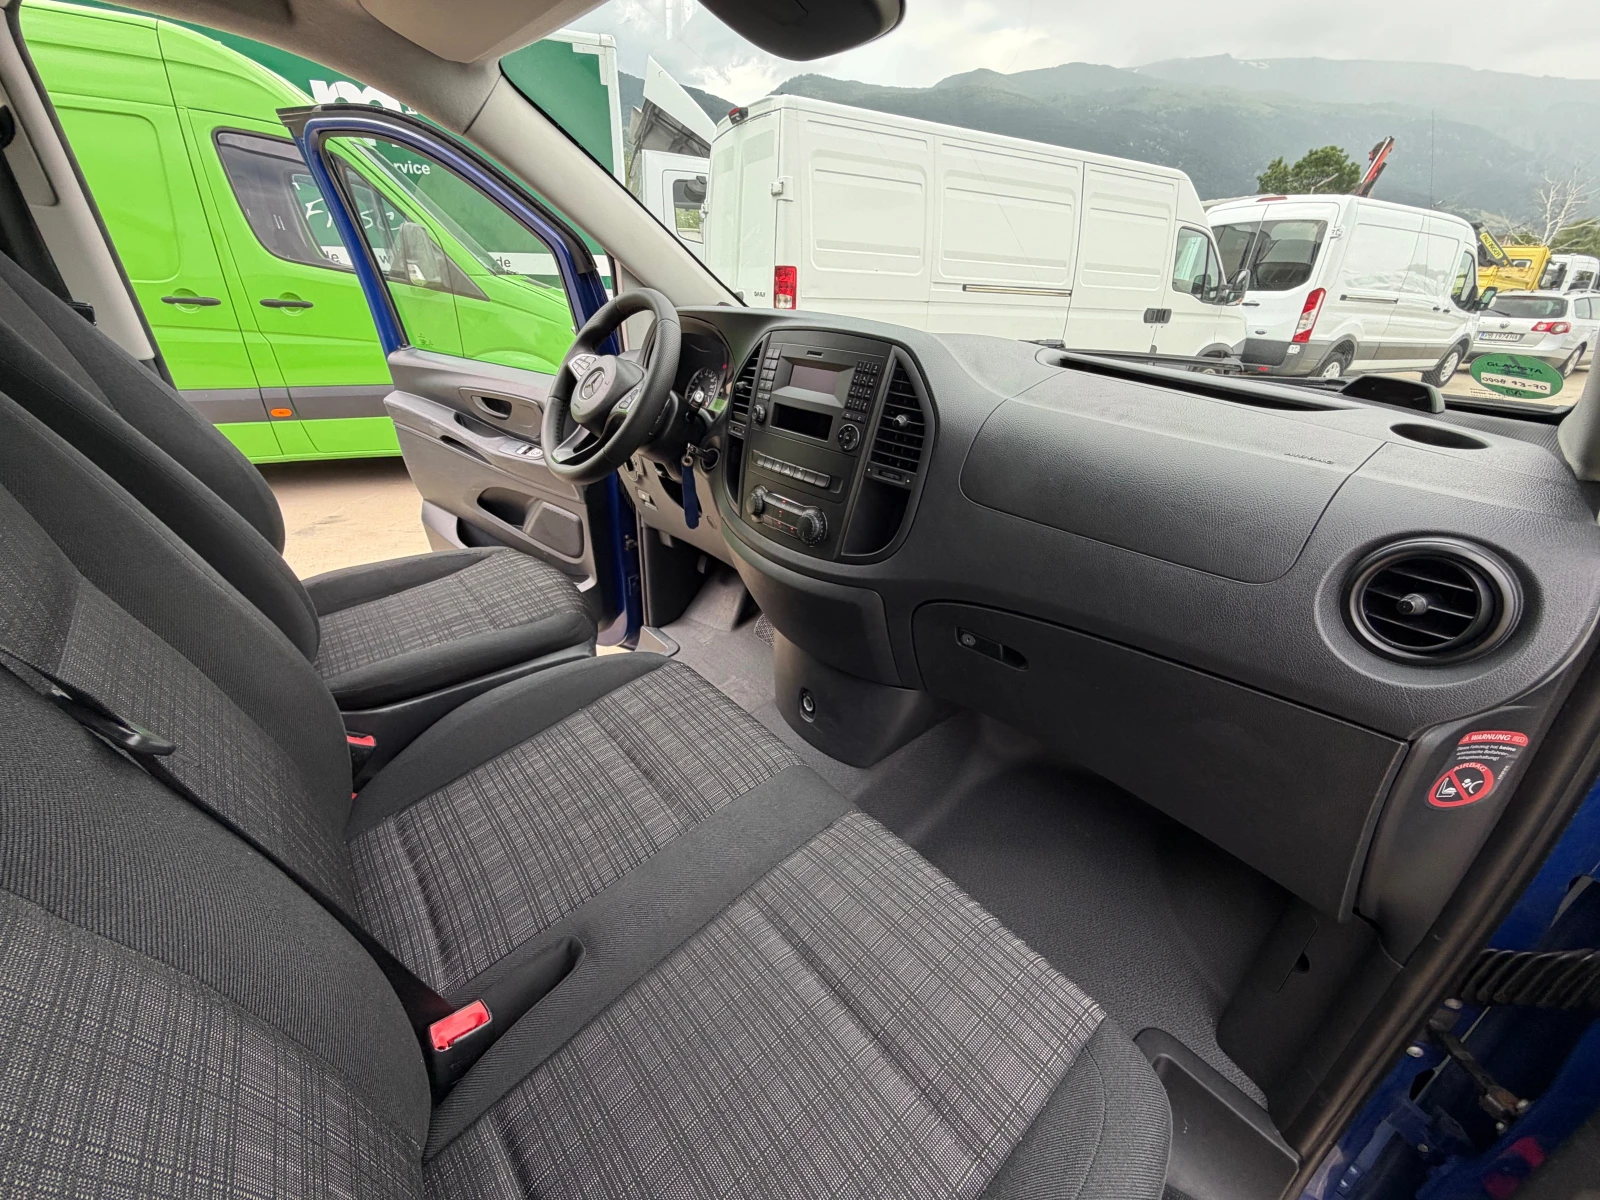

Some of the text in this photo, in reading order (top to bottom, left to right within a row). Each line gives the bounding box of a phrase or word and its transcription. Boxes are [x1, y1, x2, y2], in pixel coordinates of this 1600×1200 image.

[393, 160, 431, 175] rvice
[1487, 362, 1542, 374] GLAVISTA
[1453, 762, 1486, 772] AIRBAG
